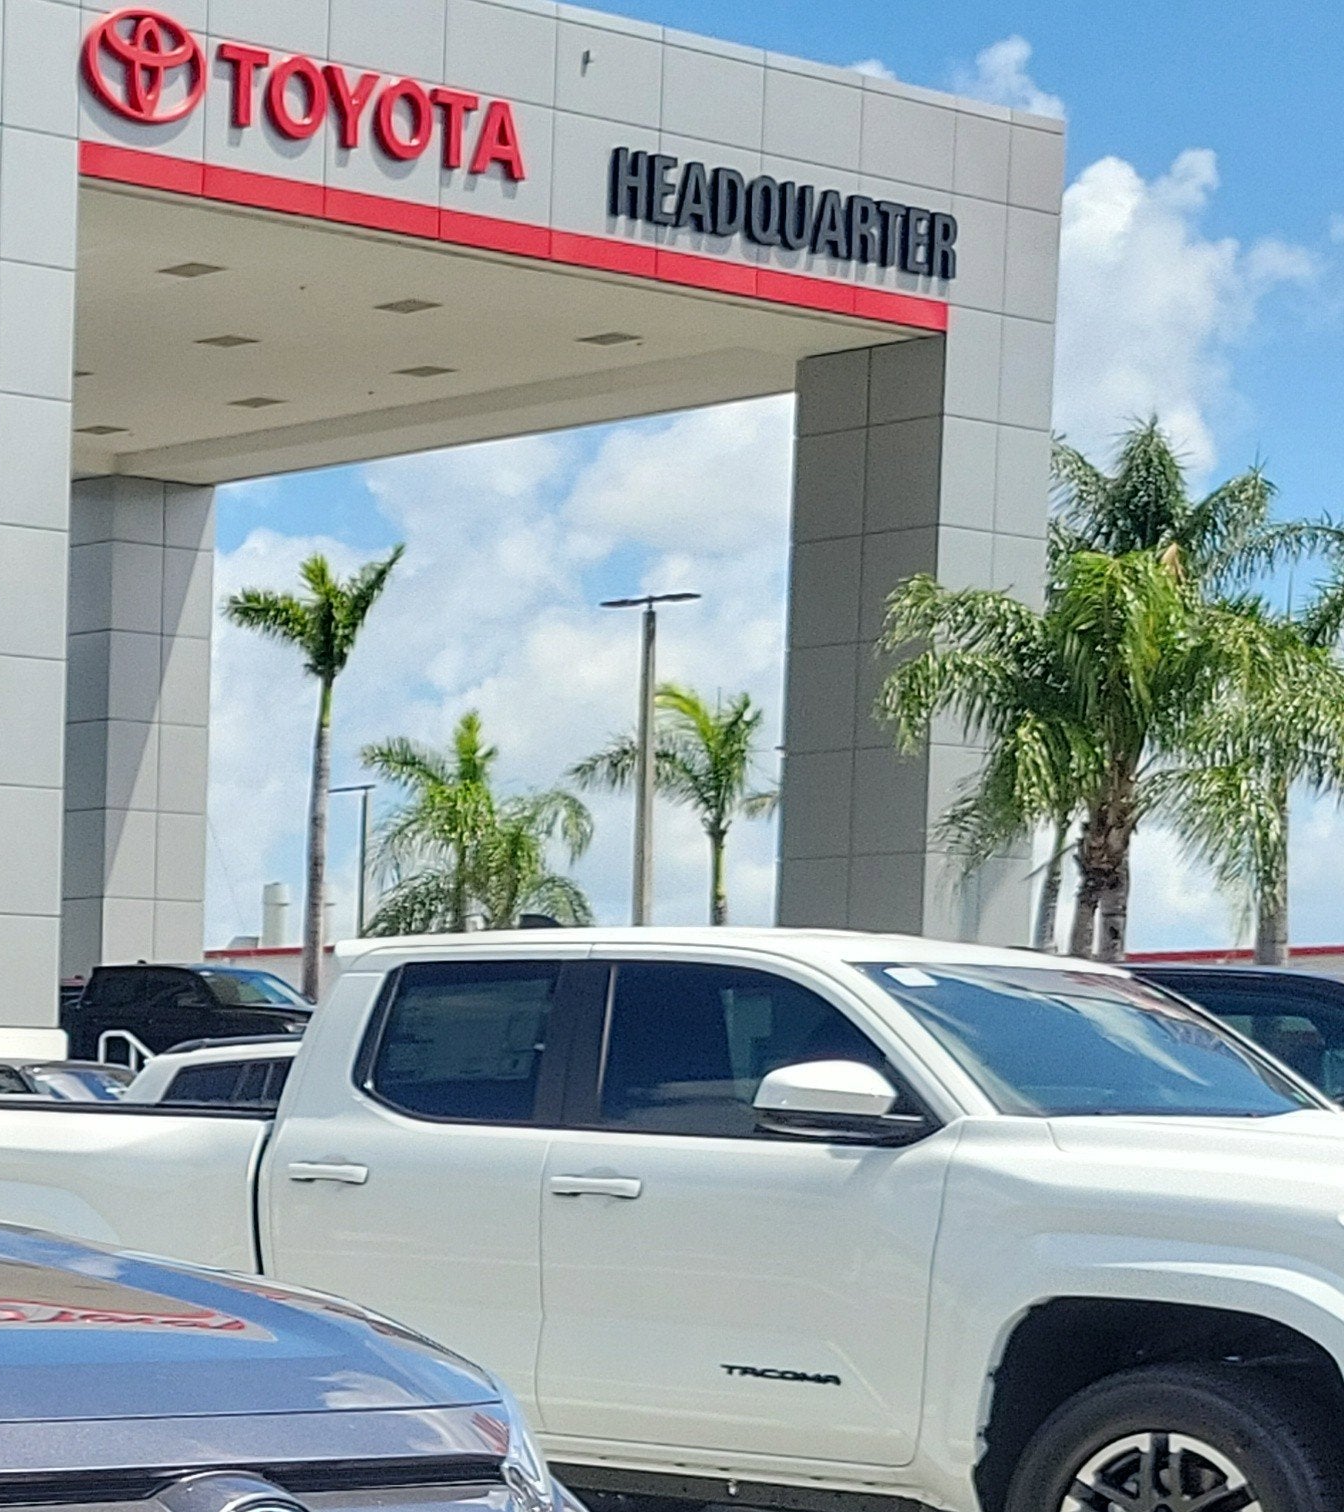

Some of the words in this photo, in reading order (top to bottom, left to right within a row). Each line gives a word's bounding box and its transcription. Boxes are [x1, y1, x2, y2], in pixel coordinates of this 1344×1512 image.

[217, 43, 526, 181] TOYOTA
[608, 146, 959, 280] HEADQUARTER
[720, 1363, 842, 1386] TACOMA
